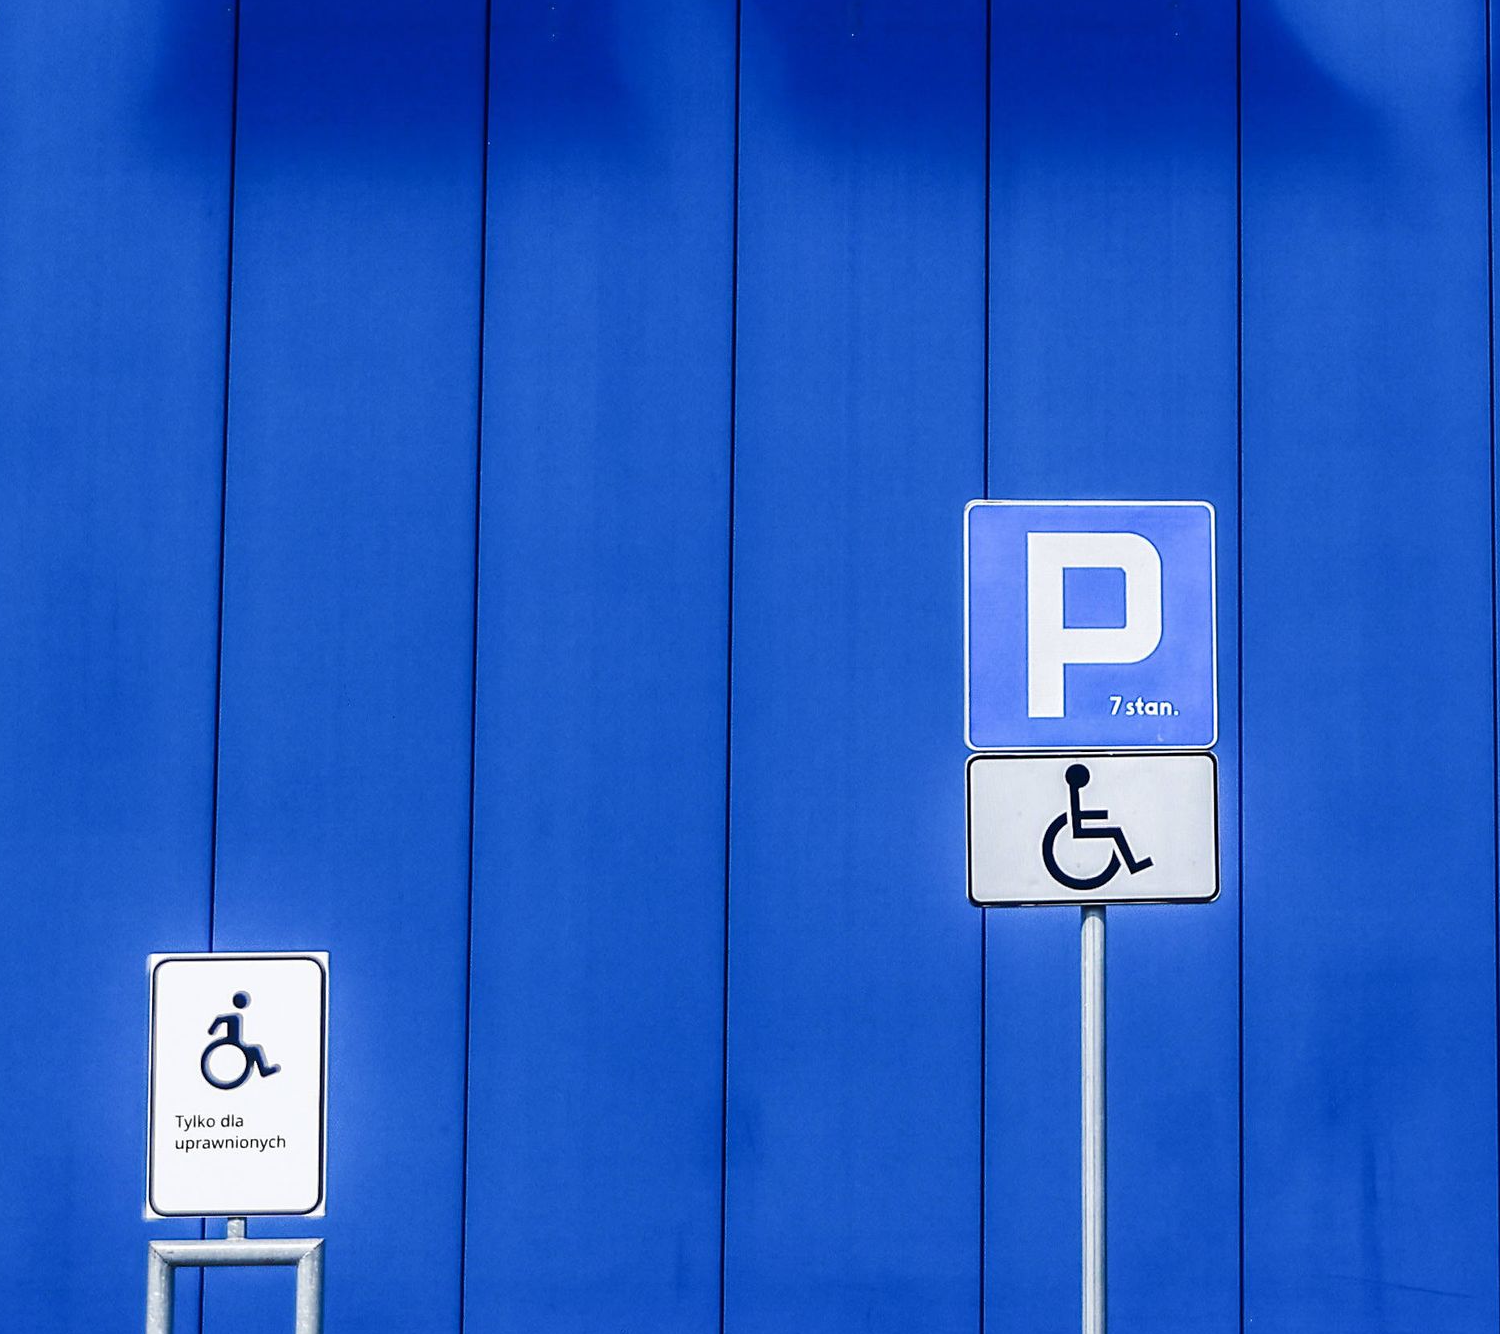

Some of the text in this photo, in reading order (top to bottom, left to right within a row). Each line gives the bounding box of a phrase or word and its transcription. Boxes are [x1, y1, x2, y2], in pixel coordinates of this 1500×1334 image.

[1027, 532, 1163, 719] P
[1109, 696, 1180, 716] 7 stan.
[175, 1114, 245, 1132] Tylko dla
[175, 1135, 287, 1153] uprawnionych
